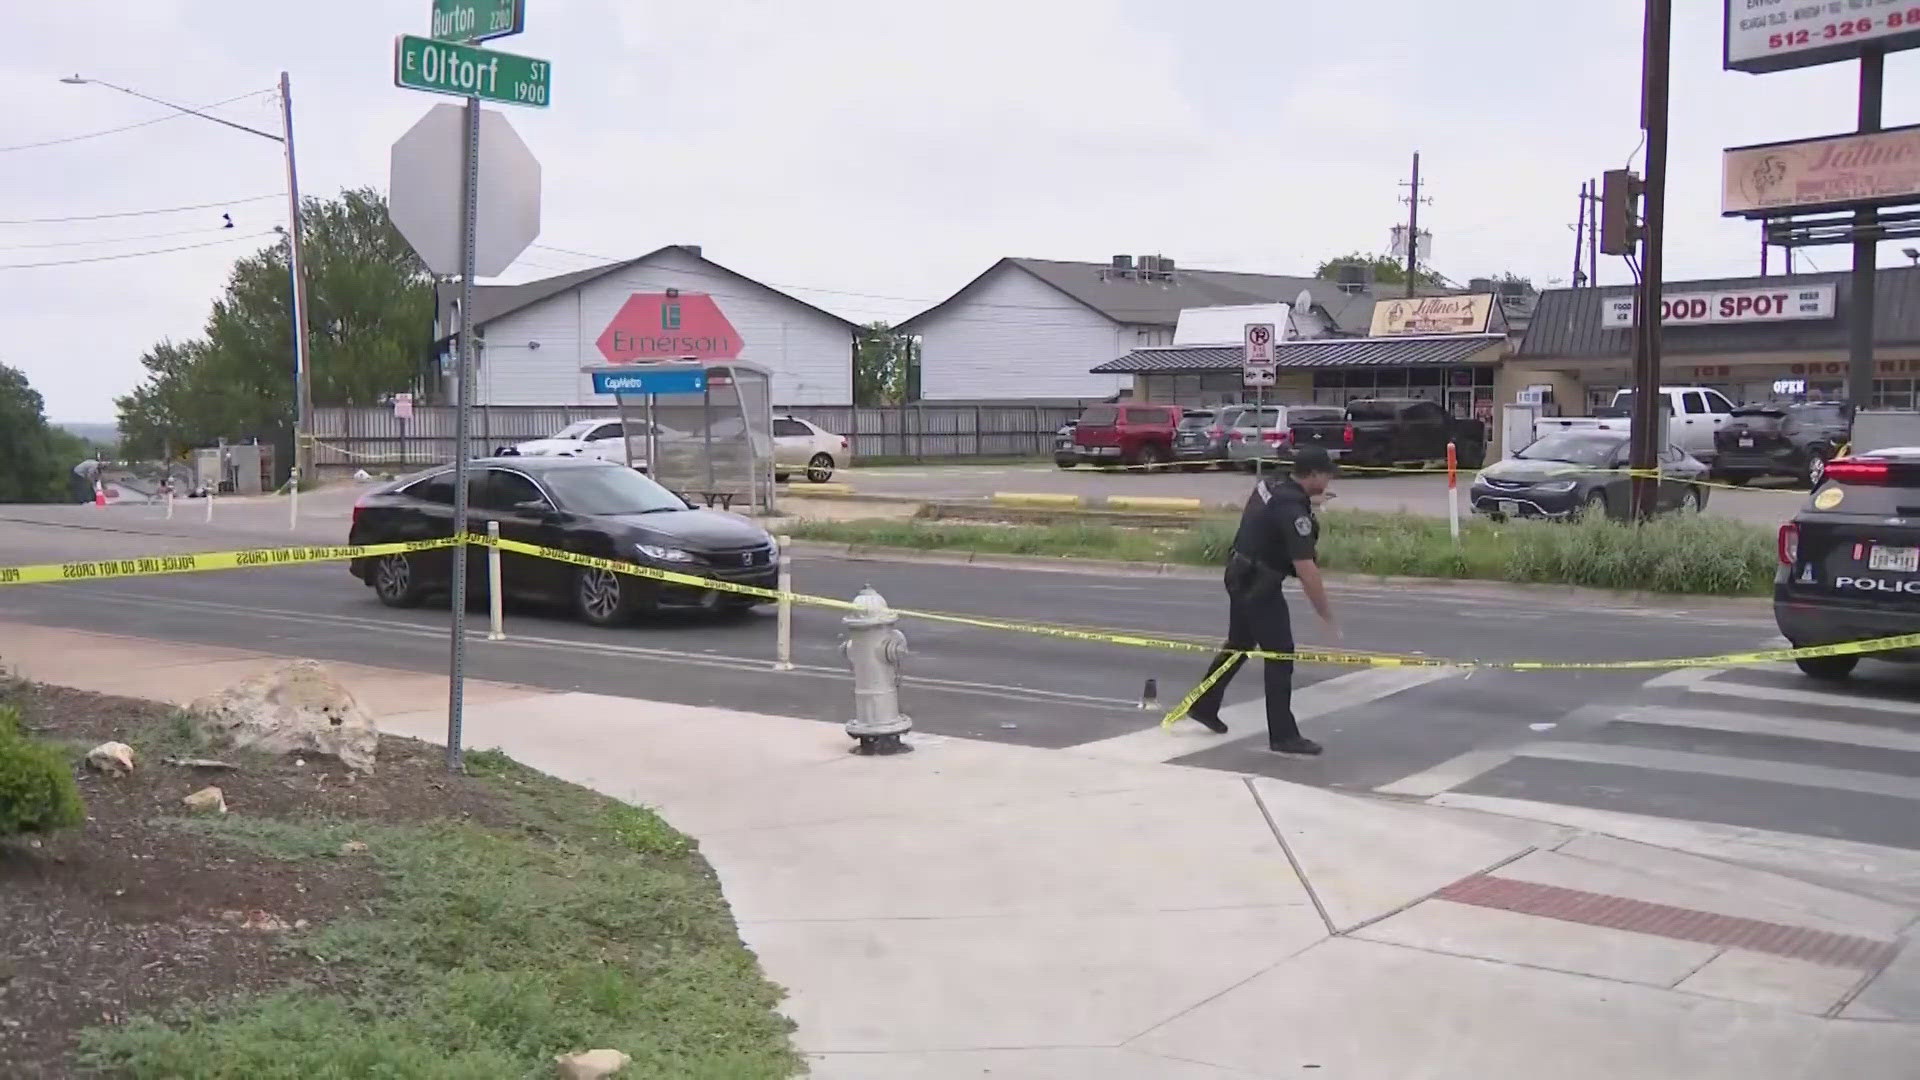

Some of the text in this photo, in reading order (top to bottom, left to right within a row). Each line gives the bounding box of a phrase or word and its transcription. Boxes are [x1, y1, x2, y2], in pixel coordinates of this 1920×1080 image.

[434, 6, 475, 36] Burton
[406, 46, 546, 92] E Oltorf ST
[514, 81, 546, 104] 1900
[1661, 295, 1789, 320] OOD SPOT
[614, 331, 728, 352] Emerson
[605, 377, 642, 390] CapMetro
[1773, 380, 1805, 394] OPEN
